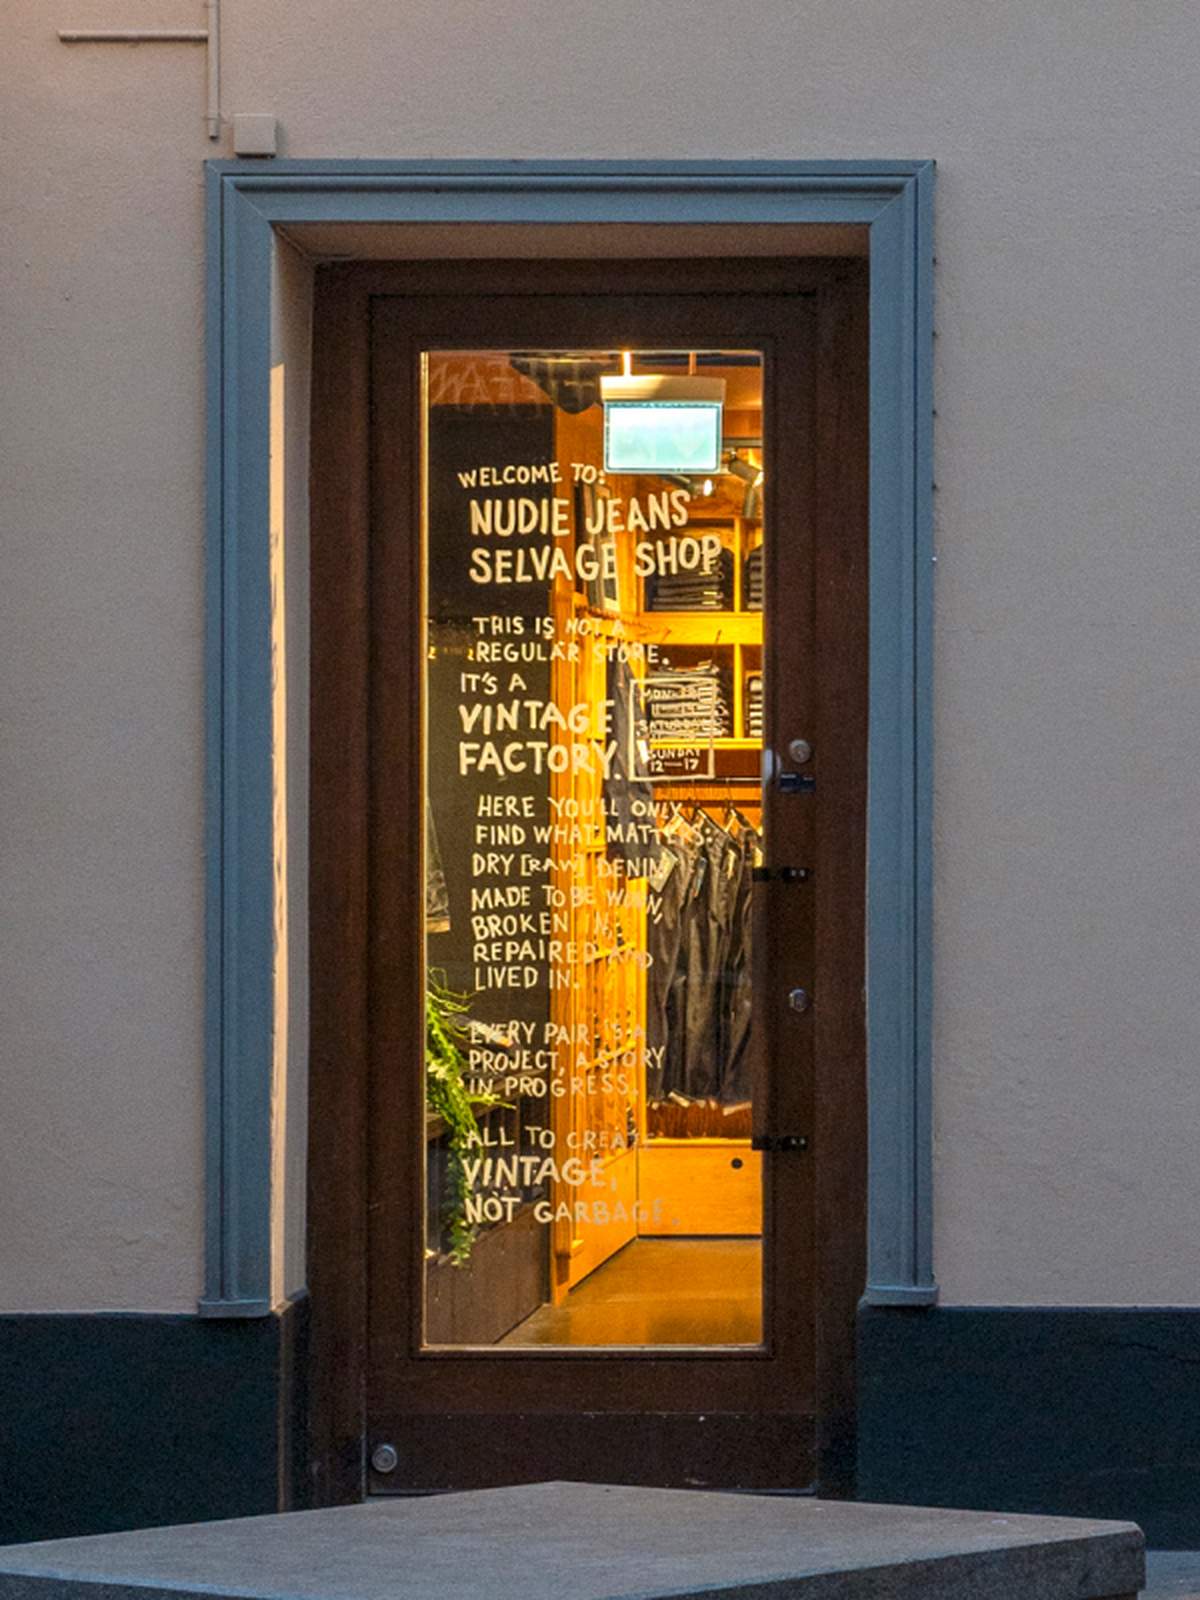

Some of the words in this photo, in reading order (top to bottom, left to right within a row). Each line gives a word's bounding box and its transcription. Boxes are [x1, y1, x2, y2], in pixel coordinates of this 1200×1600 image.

[458, 462, 562, 489] WELCOME
[570, 463, 606, 484] TO:
[470, 498, 570, 537] NUDIE
[585, 489, 691, 533] JEANS
[469, 544, 617, 584] SELVAGE
[633, 535, 722, 579] SHOP
[472, 616, 525, 636] THIS
[535, 616, 555, 639] IS
[565, 618, 603, 636] NOT
[612, 619, 626, 637] A
[476, 641, 580, 663] REGULAR
[592, 643, 670, 665] STORE.
[460, 672, 498, 695] IT'S
[509, 673, 527, 692] A
[458, 699, 615, 735] VINTAGE
[459, 741, 621, 780] FACTORY.
[477, 795, 535, 818] HERE
[547, 797, 619, 817] YOU'LL
[631, 799, 682, 820] ONLY
[476, 825, 526, 845] FIND
[533, 823, 598, 844] WHAT
[473, 853, 514, 877] DRY
[598, 858, 667, 878] DENIM
[471, 886, 531, 912] MADE
[542, 885, 565, 907] TO
[571, 885, 596, 908] BE
[607, 888, 663, 924] WN,
[471, 913, 569, 940] BROKEN
[473, 940, 597, 964] REPAIRED
[475, 966, 538, 991] LIVED
[549, 969, 580, 990] IN.
[470, 1020, 535, 1045] EVERY
[544, 1022, 591, 1046] PAIR
[469, 1049, 566, 1076] PROJECT,
[576, 1053, 589, 1067] A
[598, 1046, 665, 1070] STORY
[469, 1077, 493, 1095] IN
[505, 1073, 638, 1098] PROGRESS.
[466, 1127, 514, 1149] ALL
[524, 1125, 556, 1149] TO
[566, 1130, 656, 1151] CREATE
[461, 1154, 618, 1192] VINTAGE,
[465, 1193, 521, 1224] NOT
